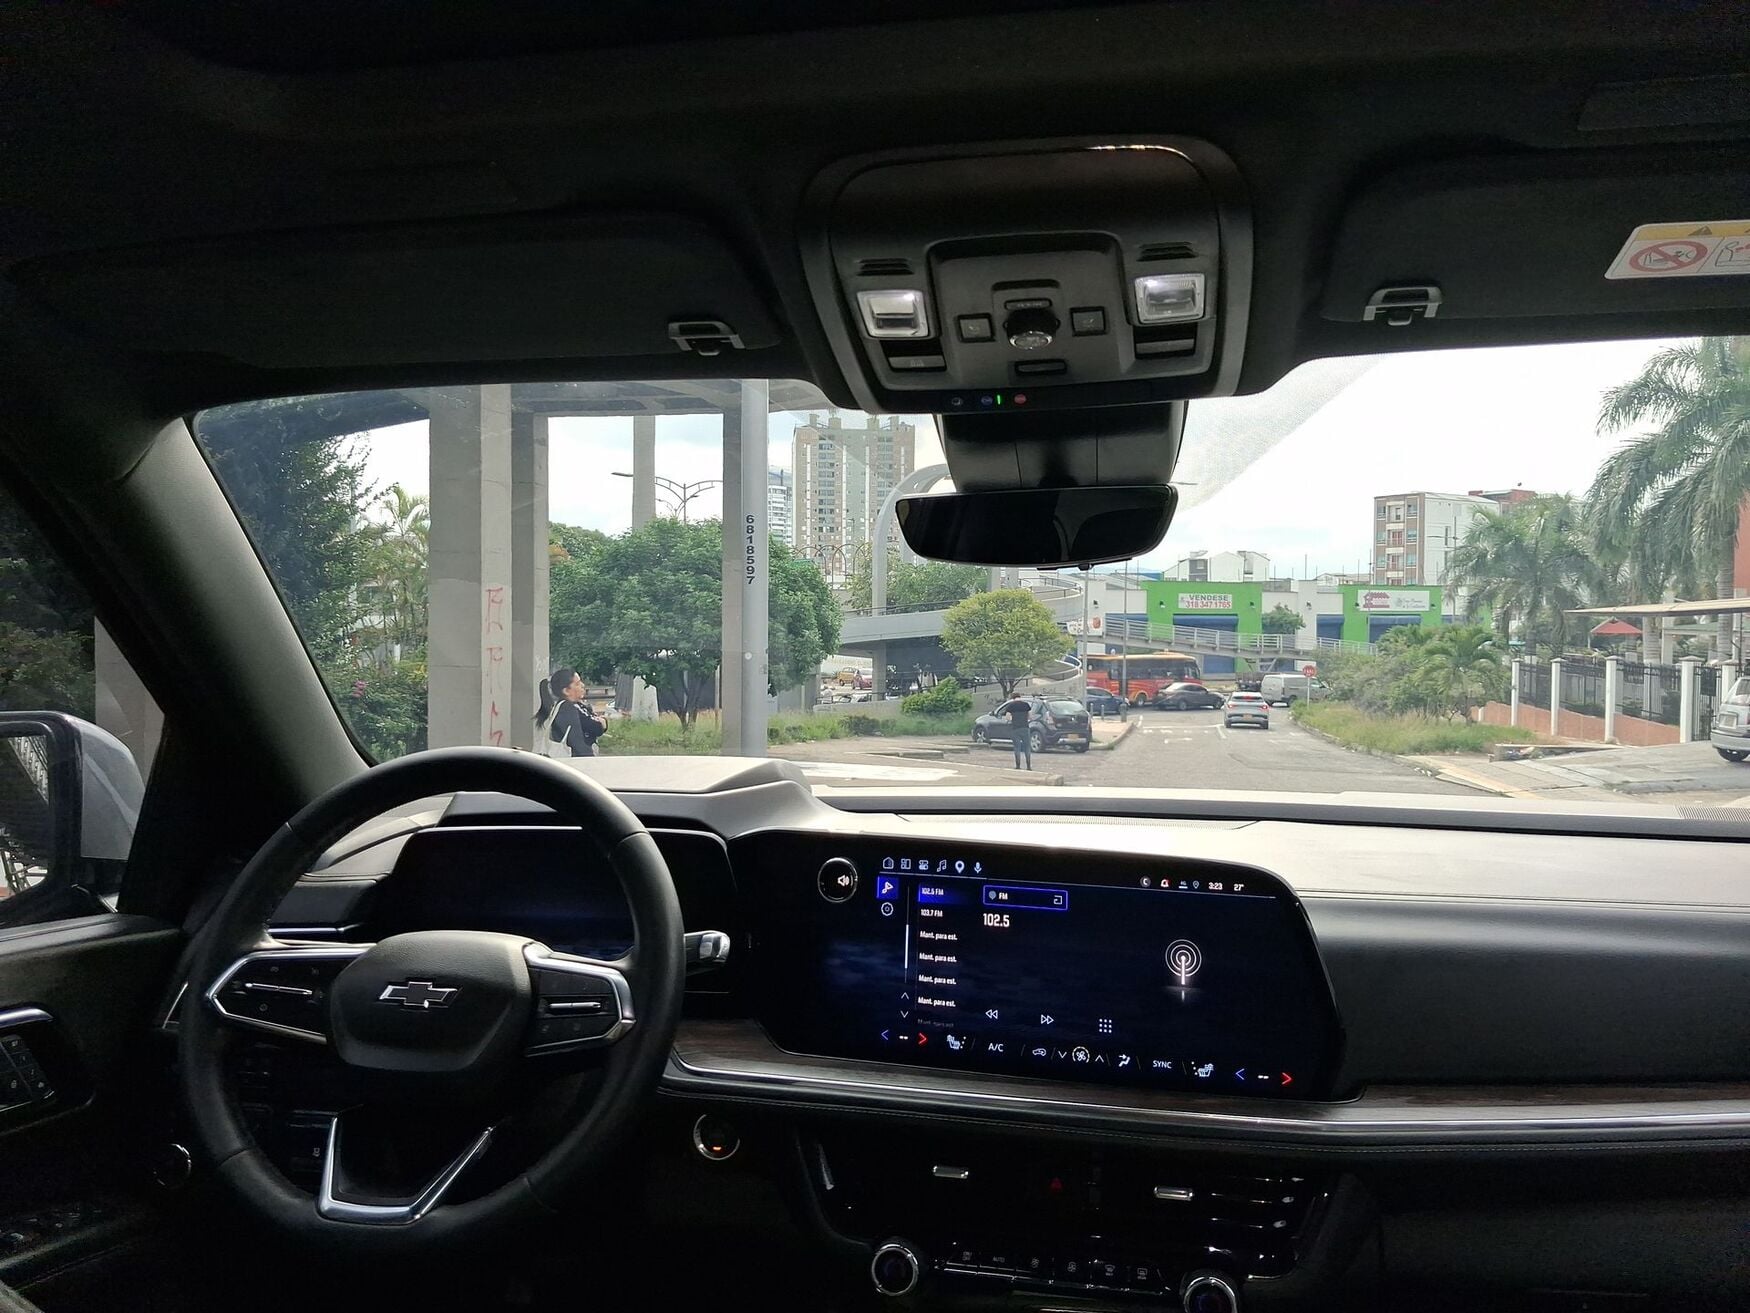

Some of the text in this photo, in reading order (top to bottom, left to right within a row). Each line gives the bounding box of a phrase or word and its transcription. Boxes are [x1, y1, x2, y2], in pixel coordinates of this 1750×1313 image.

[746, 514, 755, 584] 6818597
[1208, 882, 1223, 890] 3:23
[999, 892, 1008, 900] FM
[934, 910, 943, 918] FM
[983, 913, 1010, 928] 102.5
[935, 932, 947, 940] para
[935, 954, 946, 962] para
[933, 976, 946, 984] para
[933, 999, 945, 1007] para
[988, 1042, 1004, 1052] A/C
[1152, 1059, 1172, 1069] SYNC
